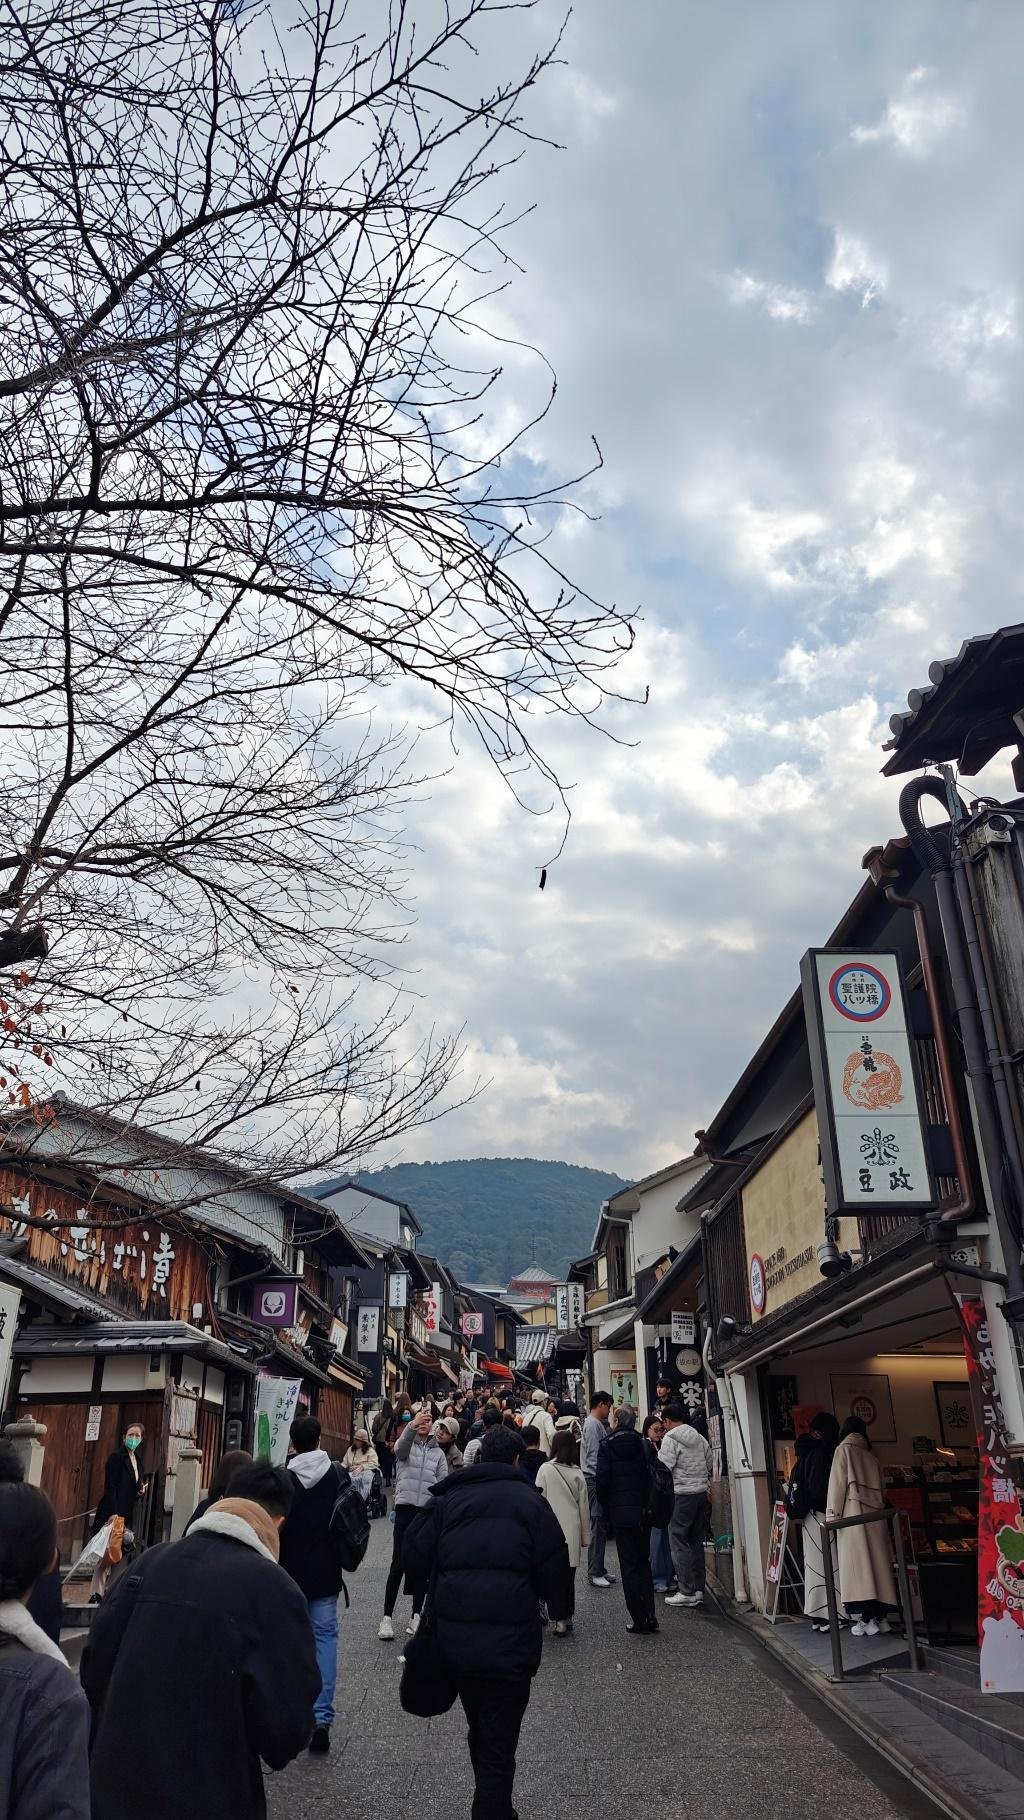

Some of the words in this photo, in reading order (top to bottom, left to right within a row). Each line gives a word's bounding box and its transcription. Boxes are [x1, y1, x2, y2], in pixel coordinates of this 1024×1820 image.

[841, 983, 878, 994] 聖護院
[843, 995, 879, 1005] 八ツ橋
[860, 1042, 877, 1072] 雲龍
[859, 1167, 914, 1193] 豆政
[283, 1385, 298, 1421] 冷やし
[271, 1397, 285, 1448] きゅうり
